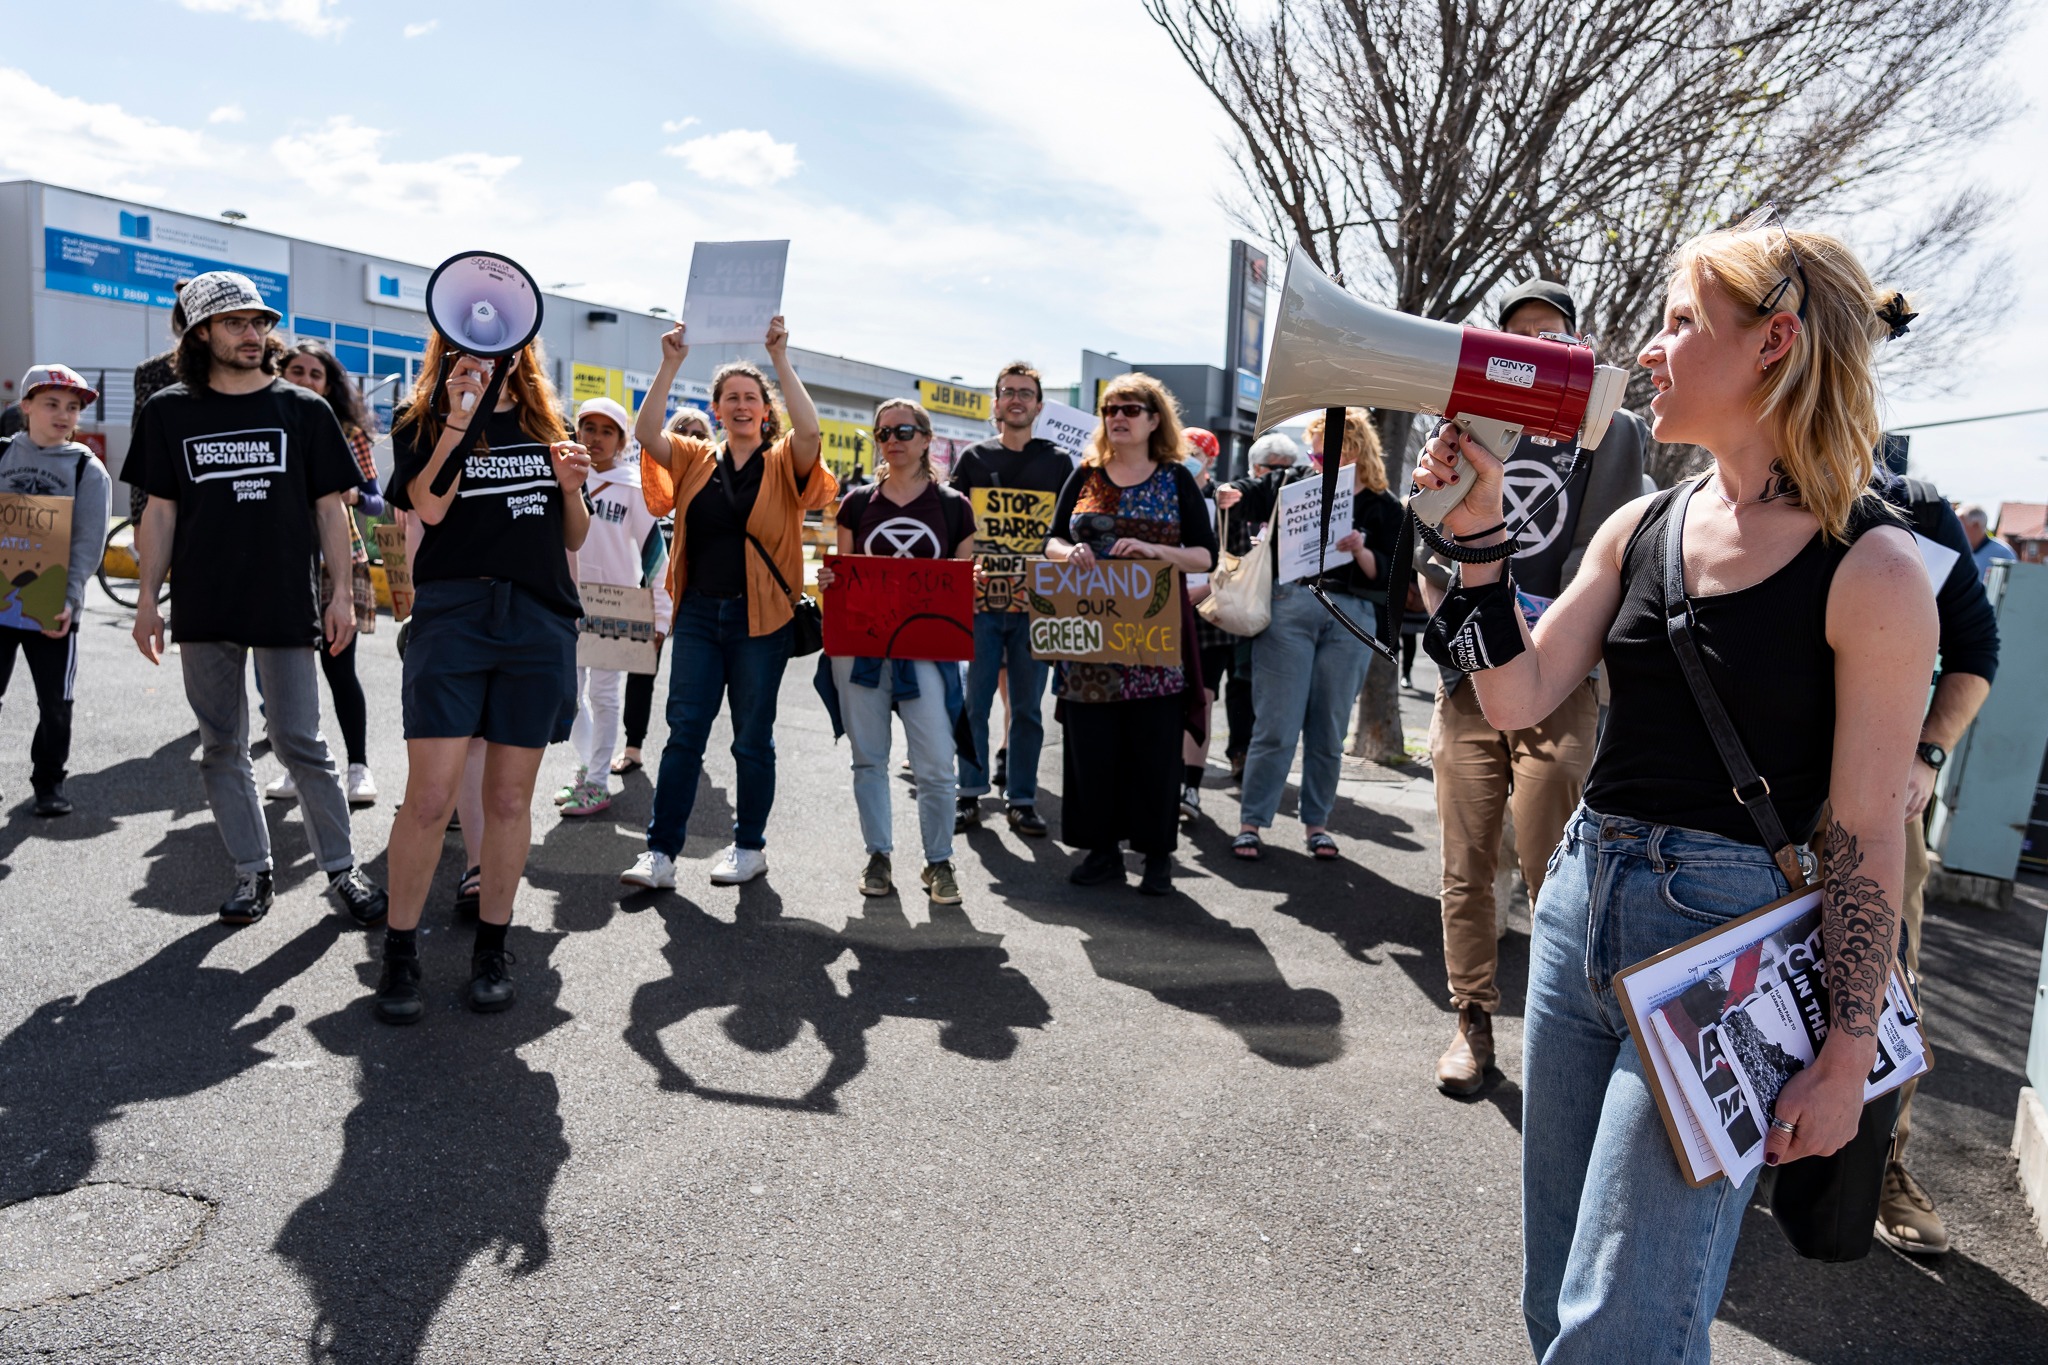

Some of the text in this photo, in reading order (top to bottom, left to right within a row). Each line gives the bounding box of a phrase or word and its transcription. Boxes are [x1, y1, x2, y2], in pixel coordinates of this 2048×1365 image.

[1492, 358, 1535, 373] VONYX
[931, 385, 950, 404] JB
[953, 389, 981, 410] HI-FI
[1046, 418, 1091, 440] PROTEC
[1057, 432, 1082, 447] OUR
[193, 441, 270, 454] VICTORIAN
[196, 452, 275, 465] SOCIALISTS
[465, 455, 545, 468] VICTORIAN
[1, 466, 39, 479] VOLCOM
[465, 465, 552, 479] SOCIALISTS
[232, 478, 271, 491] people
[237, 490, 267, 503] profit
[507, 492, 548, 508] people
[986, 490, 1039, 515] STOP
[1285, 488, 1352, 516] AZKONBEL
[512, 505, 544, 520] profit
[1287, 500, 1349, 526] POLLUNG
[983, 517, 1048, 540] BARRO
[1287, 511, 1348, 537] THE WST!
[0, 536, 31, 551] ATER
[907, 569, 958, 595] OUR
[1035, 563, 1152, 599] EXPAND
[1077, 599, 1121, 618] OUR
[1031, 618, 1175, 655] GREEN SPACE
[1707, 956, 1718, 965] that
[1717, 950, 1735, 961] Victoria
[1735, 945, 1745, 953] end
[1744, 941, 1753, 950] gas
[1769, 992, 1787, 1022] LEARN MORE
[1774, 989, 1797, 1031] FLIP THIS PAGE TO
[1793, 974, 1813, 998] IN
[1805, 998, 1829, 1041] THE
[1883, 1024, 1895, 1045] INVOLVED
